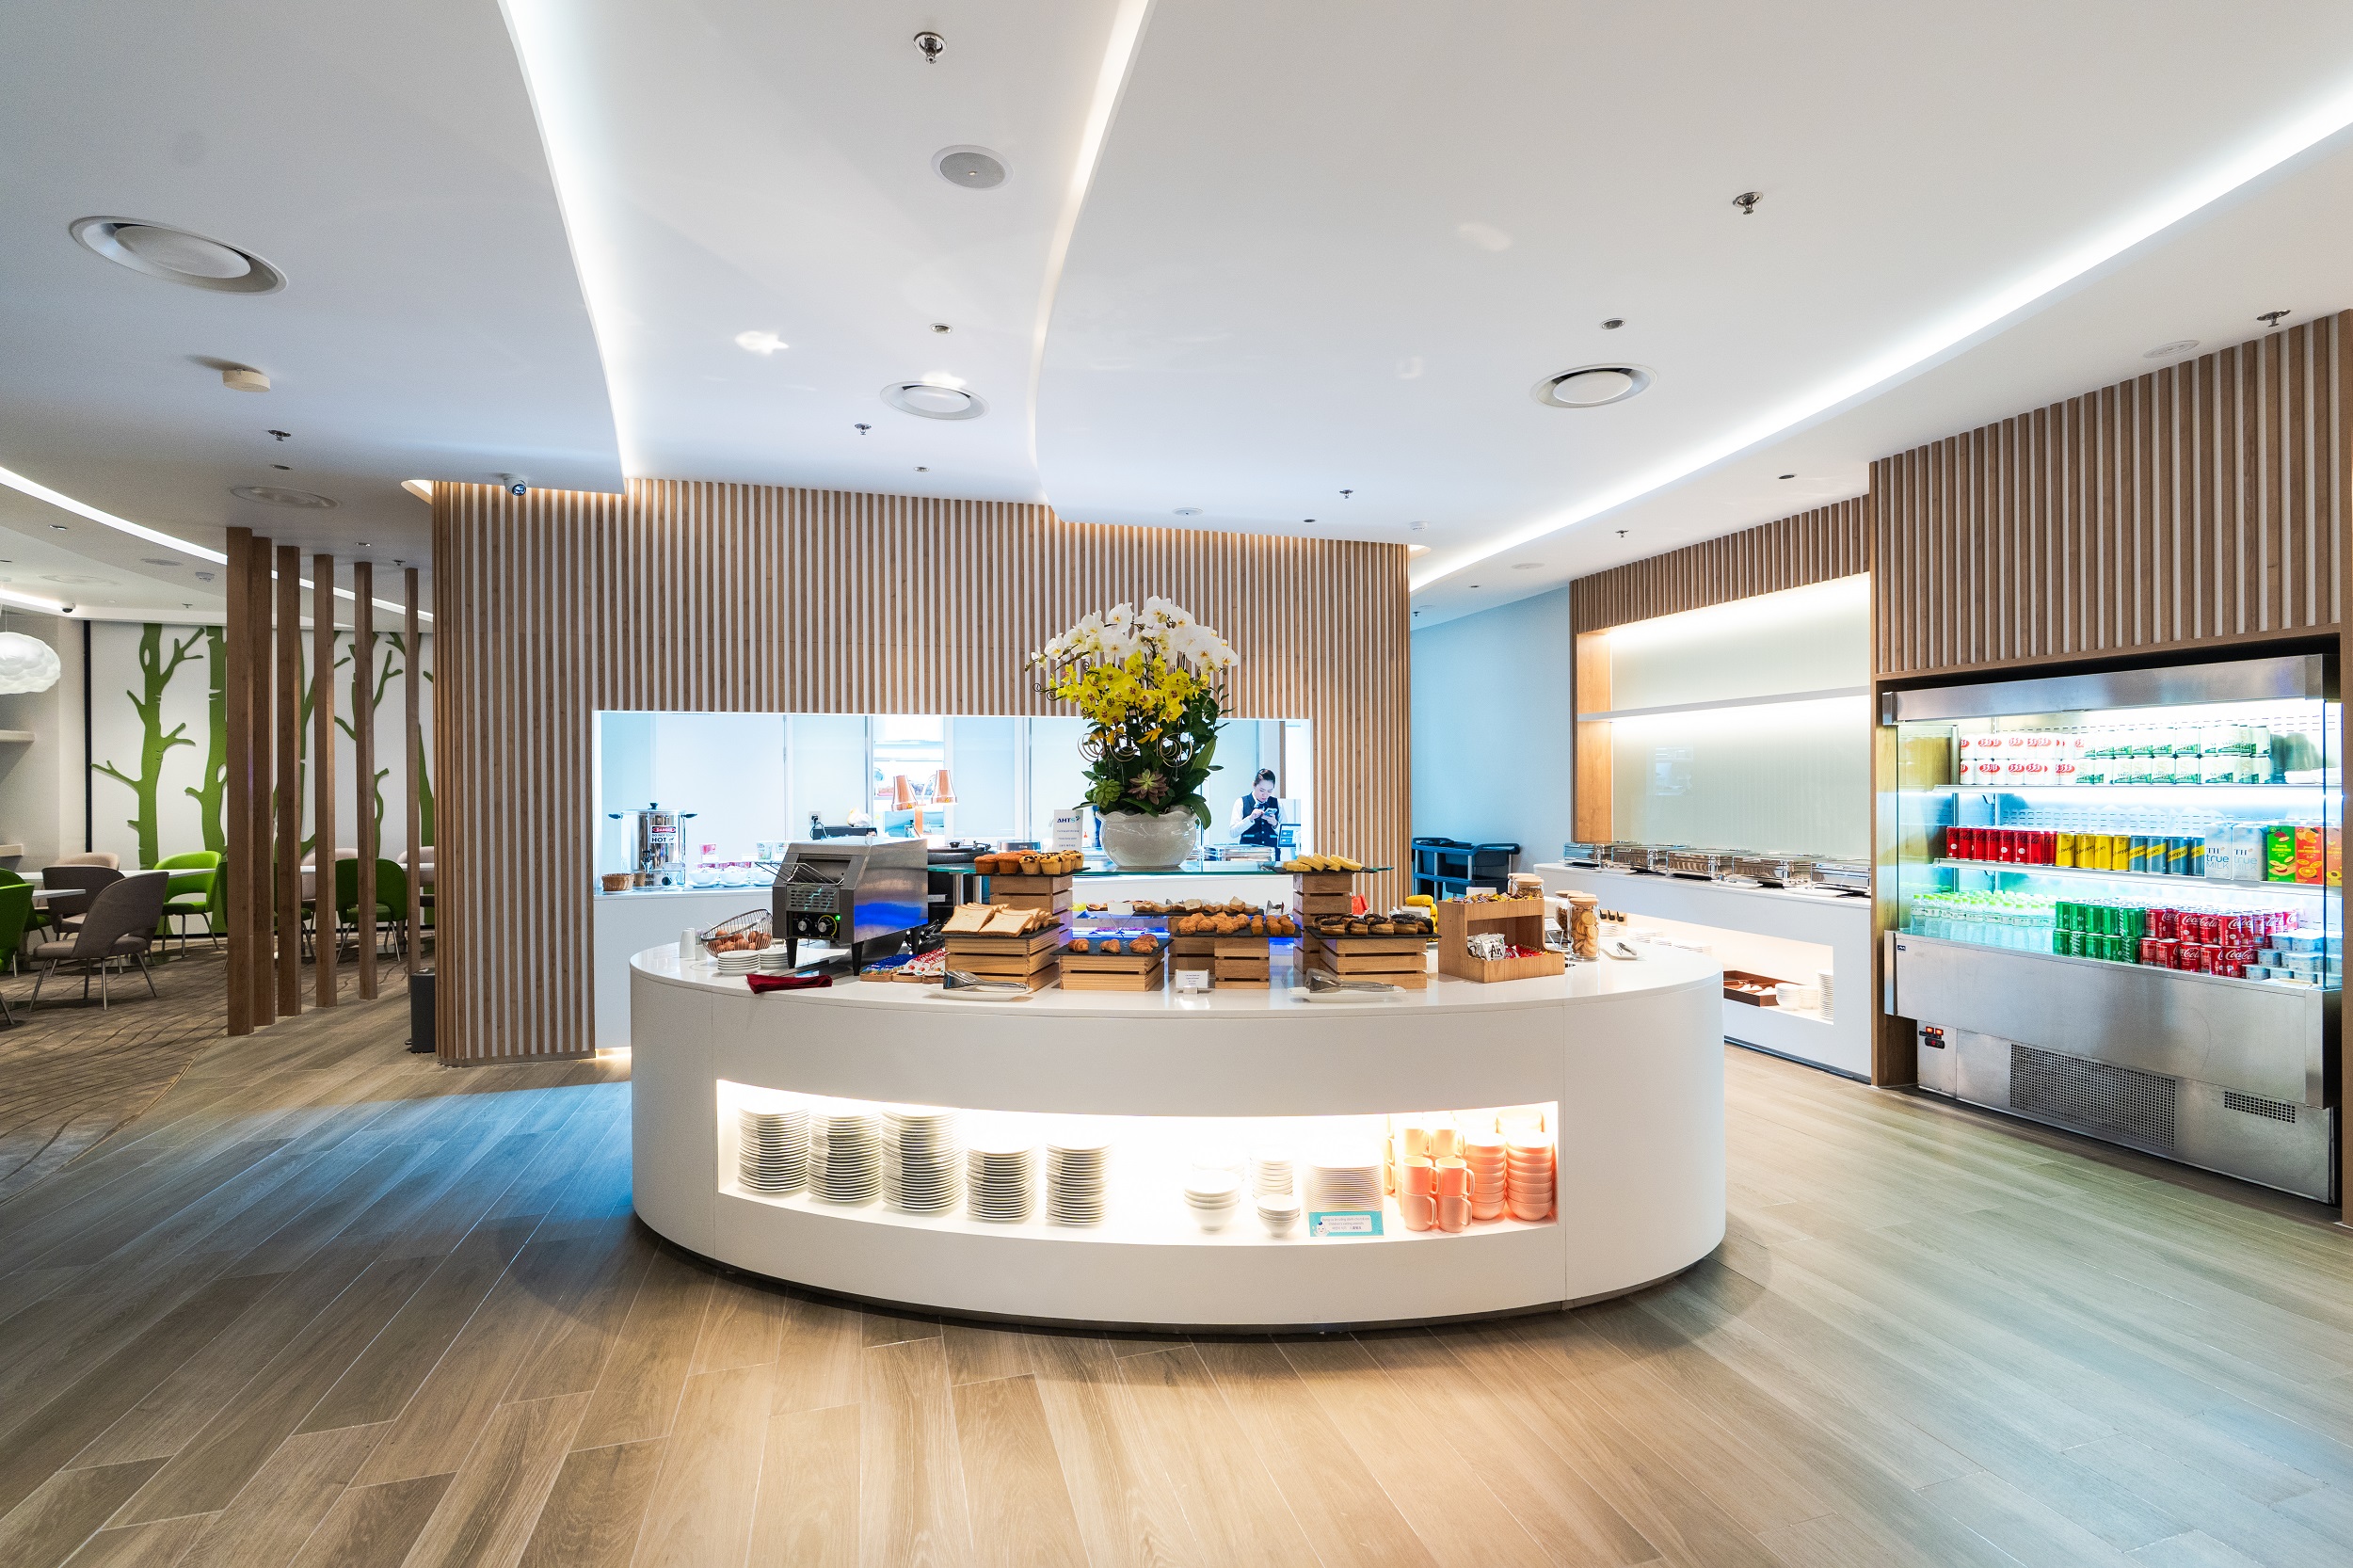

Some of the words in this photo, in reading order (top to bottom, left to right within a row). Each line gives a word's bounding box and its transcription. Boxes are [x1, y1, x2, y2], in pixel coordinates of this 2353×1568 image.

[2206, 854, 2230, 863] true
[2233, 856, 2257, 865] true
[2206, 861, 2230, 870] MILK
[2233, 863, 2257, 872] MILK
